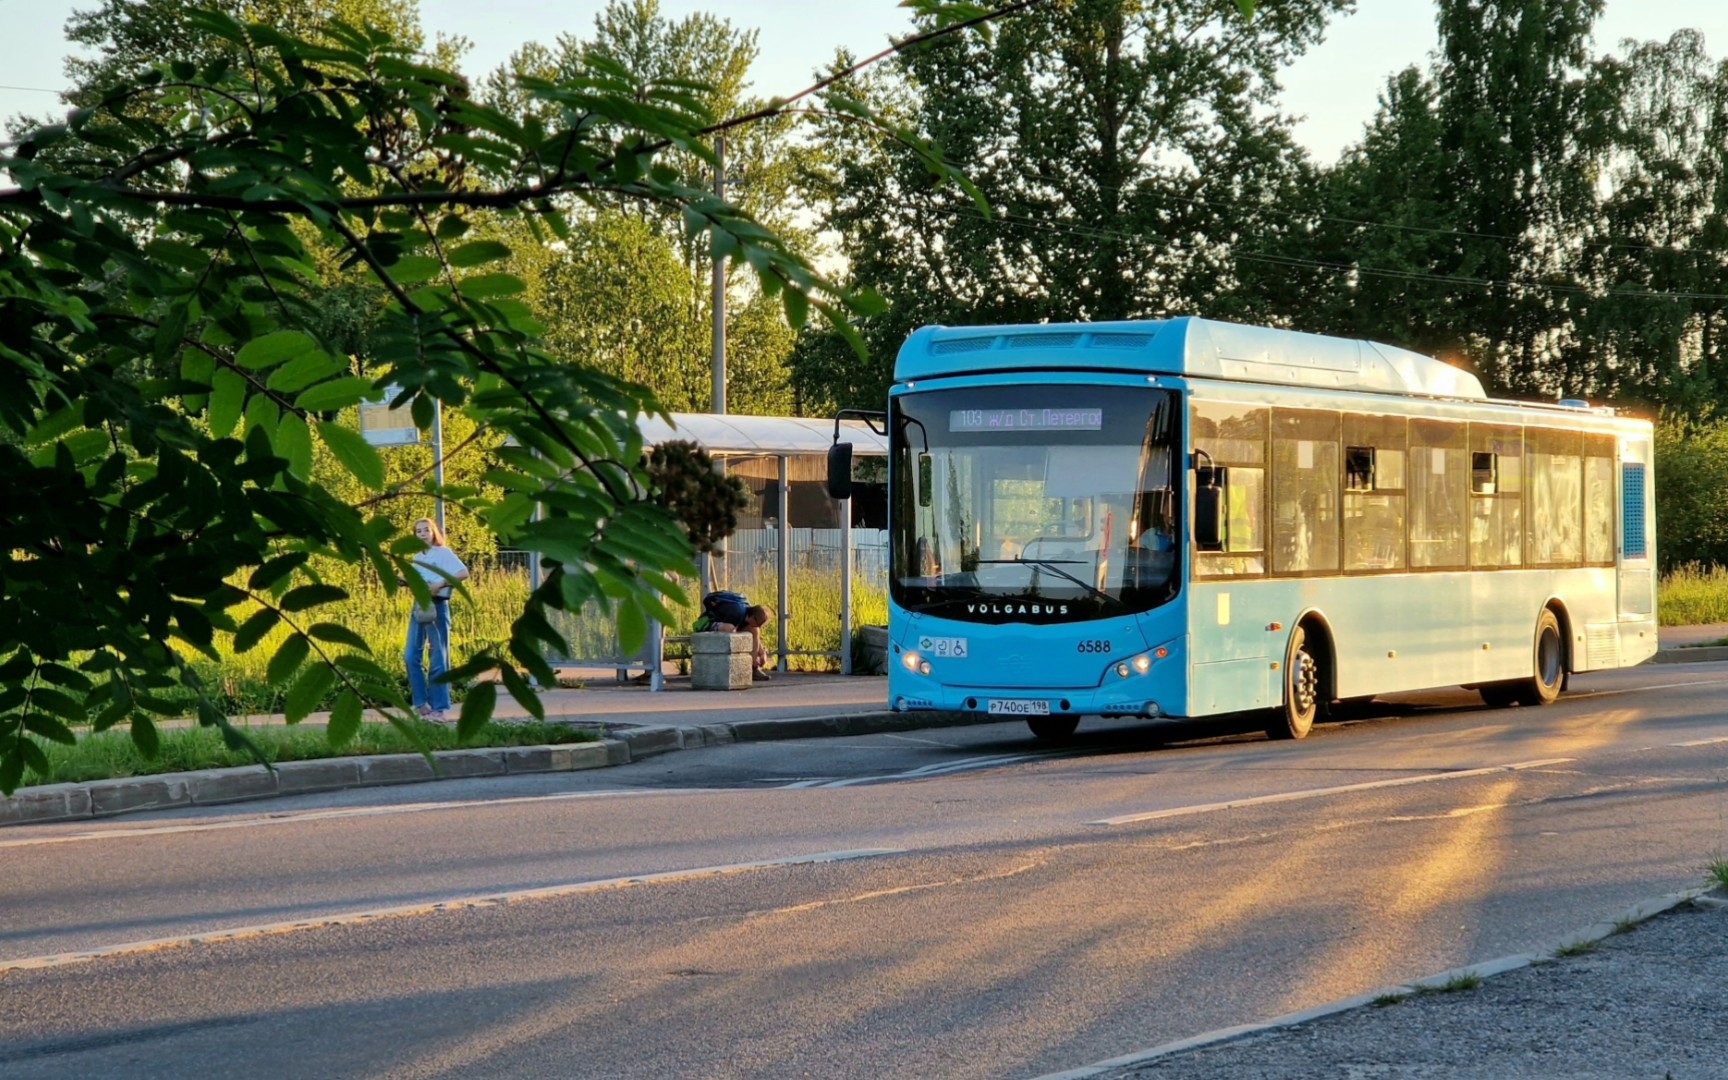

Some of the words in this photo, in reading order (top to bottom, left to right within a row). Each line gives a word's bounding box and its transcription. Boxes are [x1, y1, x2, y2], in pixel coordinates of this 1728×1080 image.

[961, 410, 982, 426] 103
[989, 411, 1014, 427] ж/д
[967, 604, 1068, 614] VOLGABUS
[1077, 640, 1111, 653] 6588
[1032, 701, 1047, 710] 198
